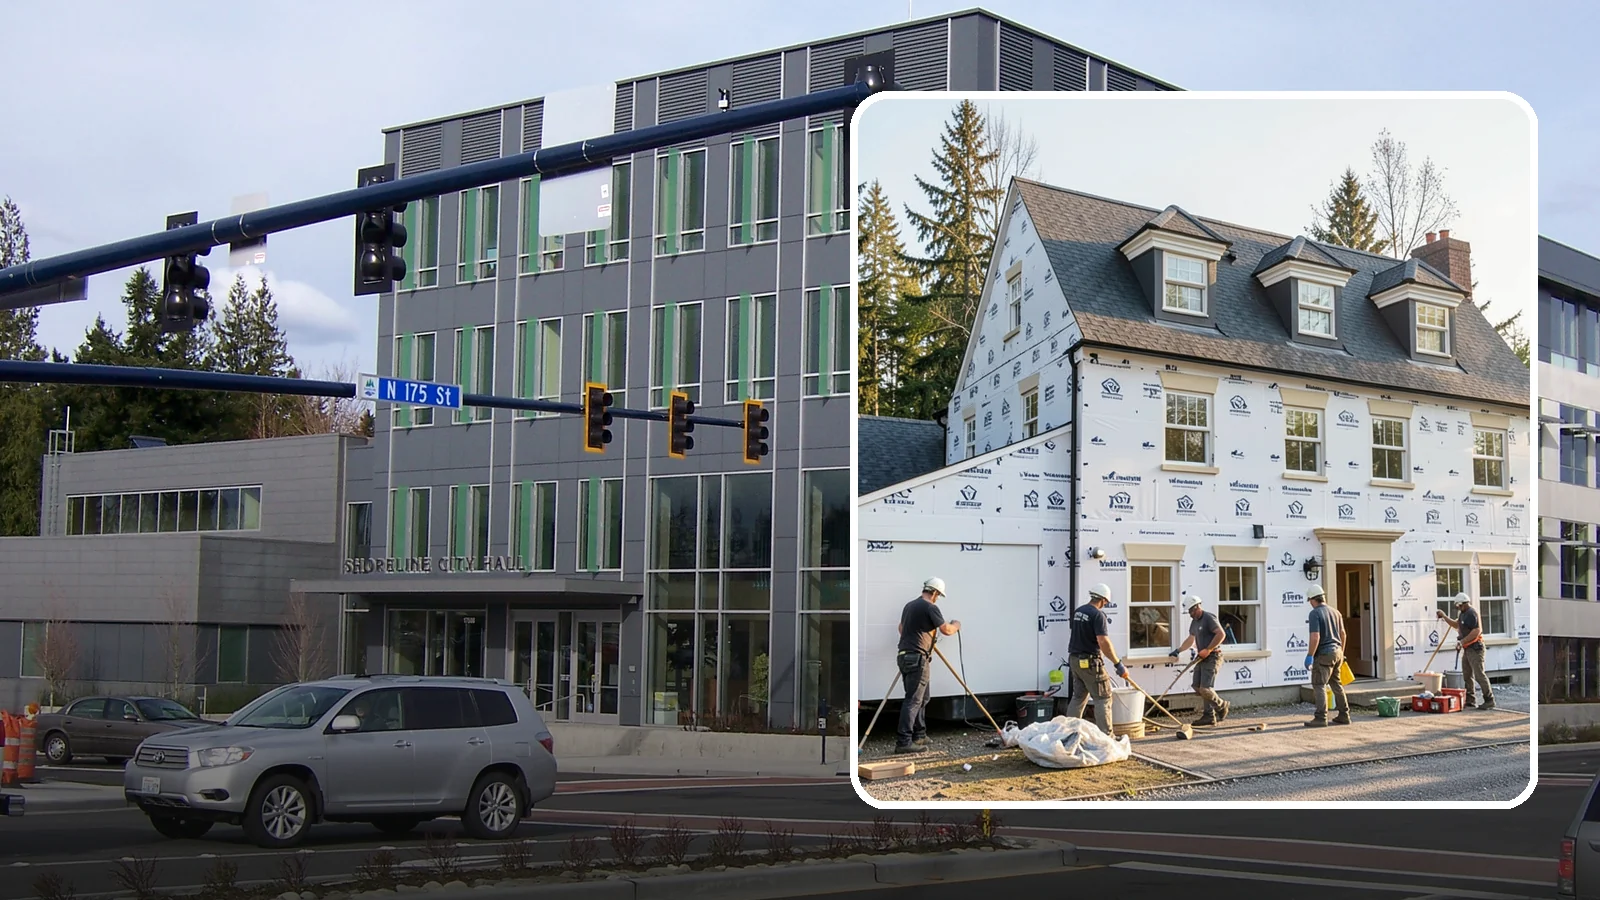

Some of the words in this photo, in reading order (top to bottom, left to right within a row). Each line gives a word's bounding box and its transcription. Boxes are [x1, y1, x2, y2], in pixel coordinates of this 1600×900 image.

[387, 380, 396, 400] N
[405, 382, 427, 403] 175
[436, 386, 451, 406] St
[344, 557, 431, 574] SHORELINE
[438, 556, 476, 572] CITY
[484, 555, 525, 571] HALL
